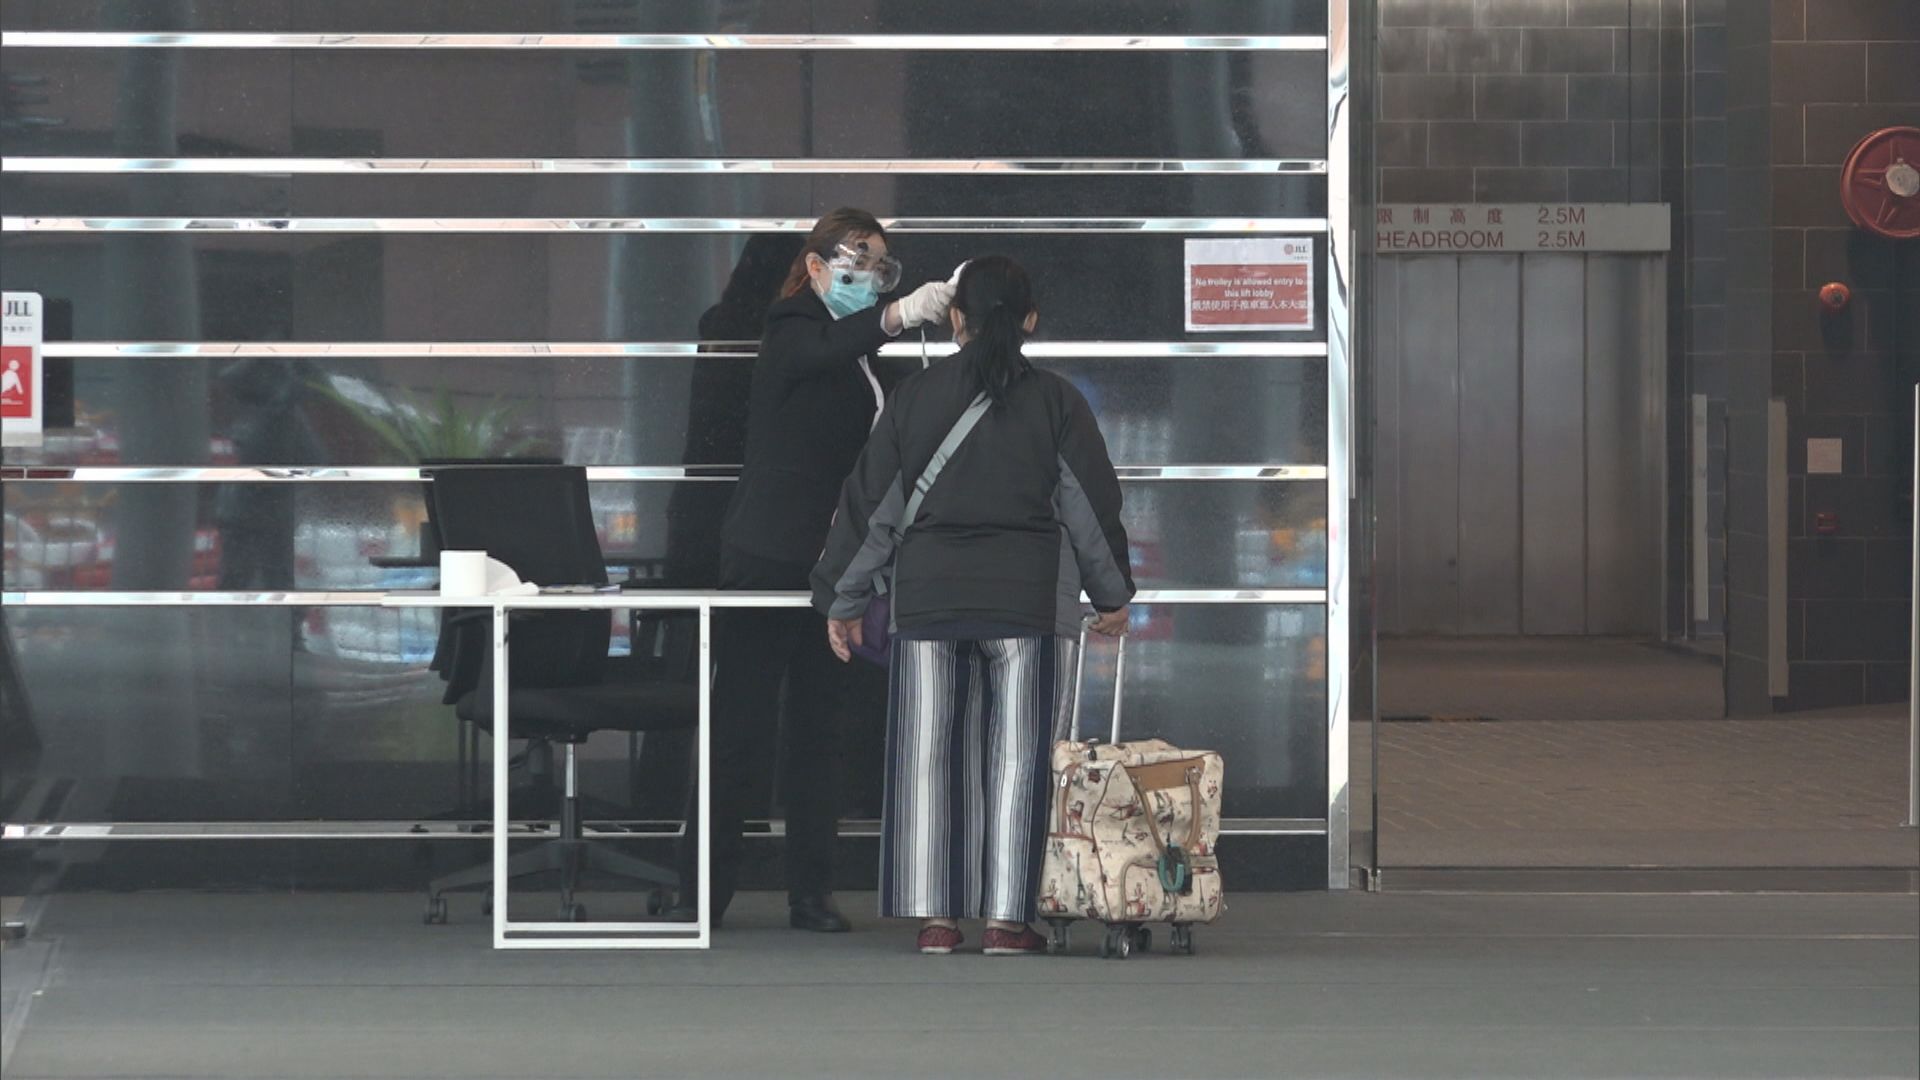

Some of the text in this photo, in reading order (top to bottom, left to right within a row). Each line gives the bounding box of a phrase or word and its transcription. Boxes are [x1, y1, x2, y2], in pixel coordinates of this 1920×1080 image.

[1537, 206, 1586, 225] 2.5M
[1376, 230, 1586, 249] HEADROOM 2.5M
[1208, 278, 1232, 288] trolley
[1233, 278, 1241, 286] is
[1242, 277, 1272, 286] allowed
[1273, 278, 1293, 287] entry
[1295, 277, 1304, 286] to
[1224, 289, 1274, 299] this lift lobby
[4, 300, 33, 317] JLL
